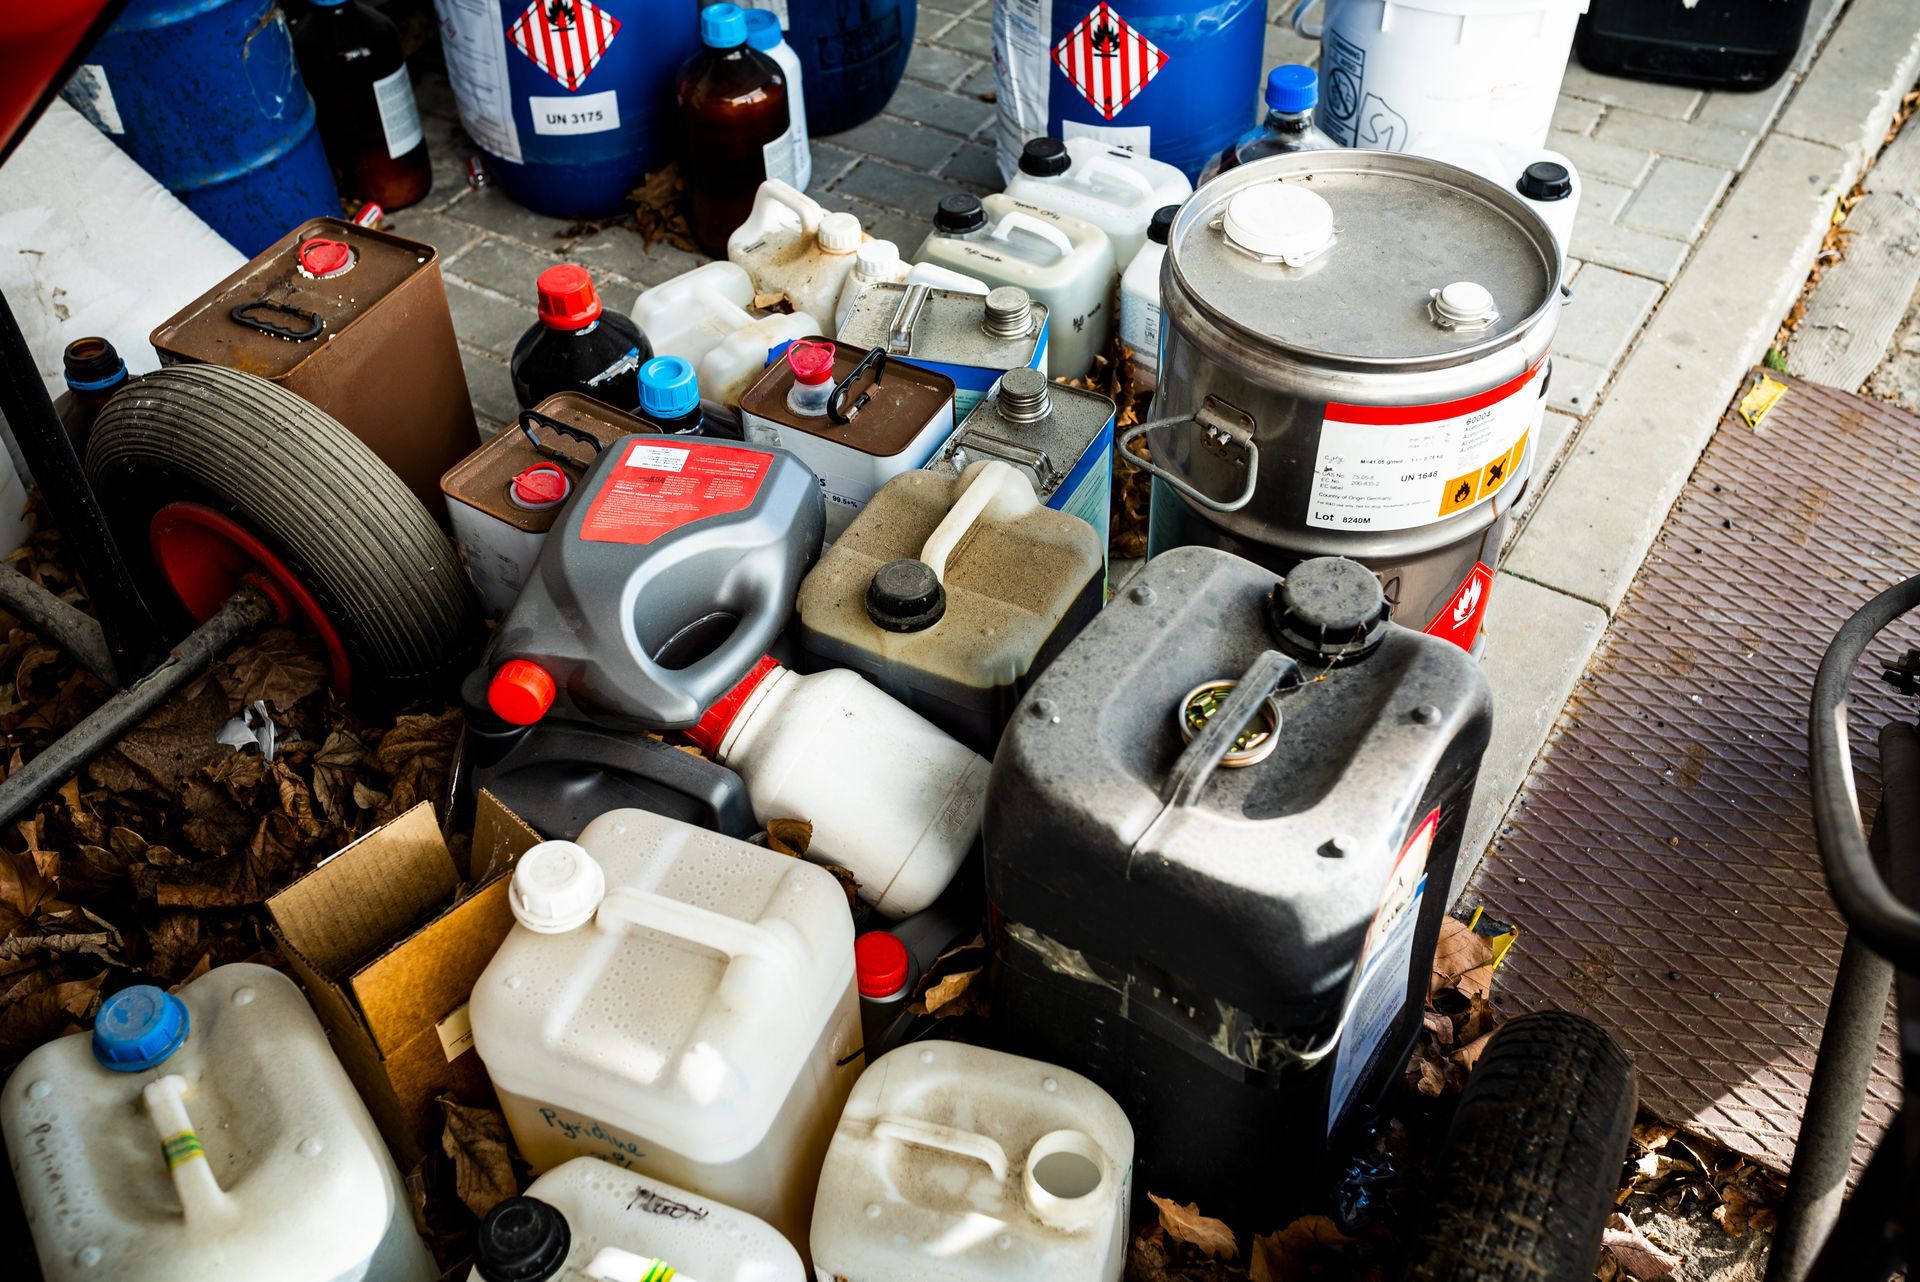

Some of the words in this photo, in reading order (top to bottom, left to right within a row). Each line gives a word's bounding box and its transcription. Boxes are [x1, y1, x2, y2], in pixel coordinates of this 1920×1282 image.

[546, 113, 567, 125] UN
[571, 110, 603, 124] 3175
[1466, 411, 1491, 425] 60004
[1418, 471, 1438, 480] 1648
[832, 495, 858, 508] 99.5+%
[1319, 491, 1340, 499] Country
[1315, 511, 1334, 521] Lot
[539, 1107, 646, 1157] Pyridine
